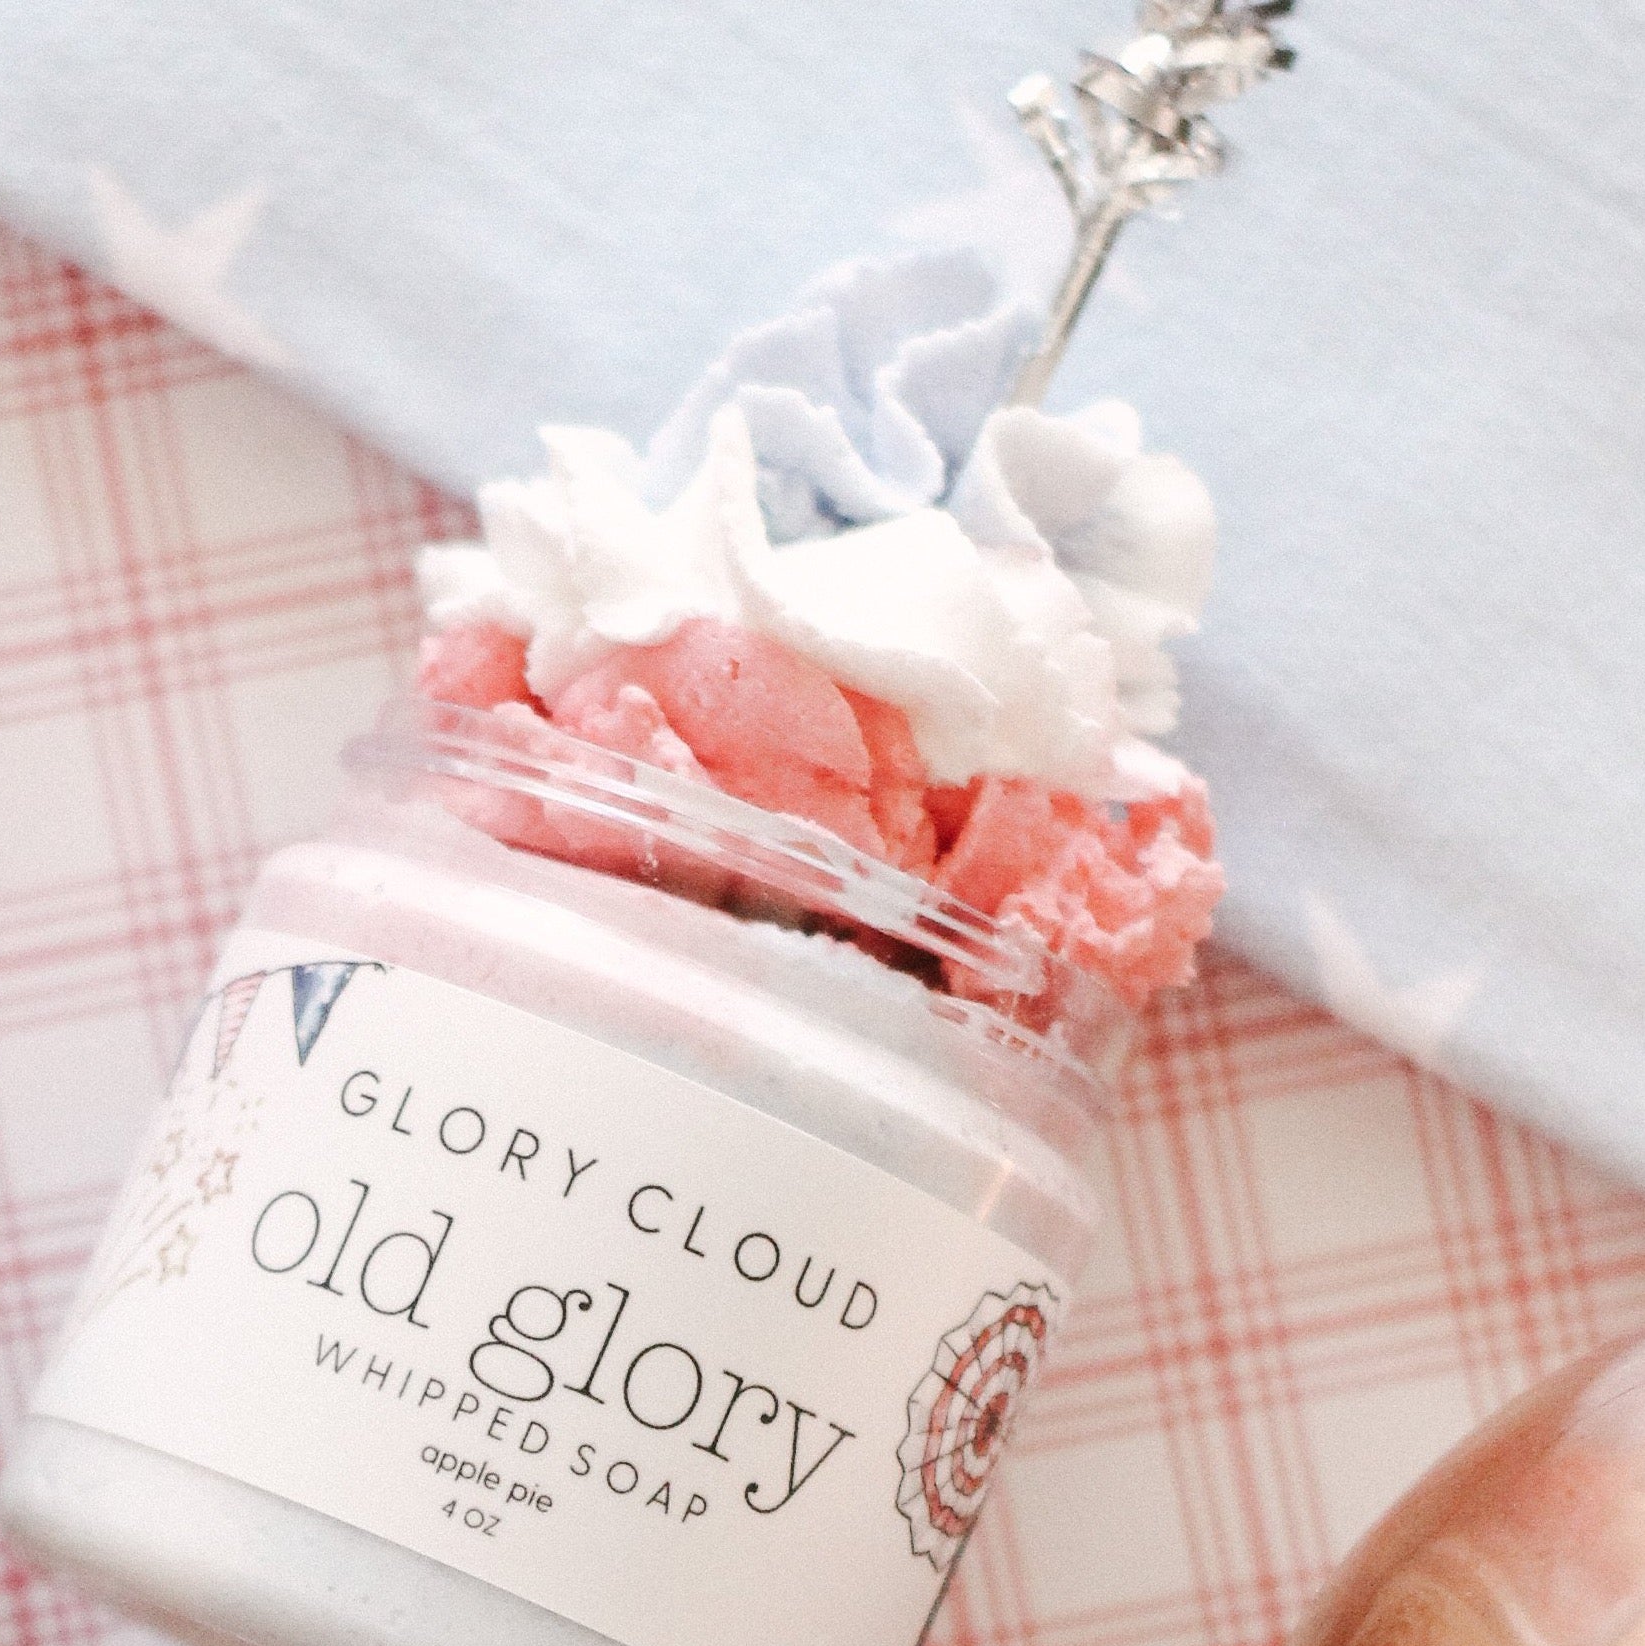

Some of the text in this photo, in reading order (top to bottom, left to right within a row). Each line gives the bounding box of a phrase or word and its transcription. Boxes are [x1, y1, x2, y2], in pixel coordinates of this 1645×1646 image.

[340, 1070, 879, 1330] GLORY CLOUD
[252, 1179, 856, 1514] old glory
[316, 1334, 708, 1524] WHIPPED SOAP
[421, 1444, 553, 1513] apple pie
[441, 1499, 502, 1537] 4 OZ
